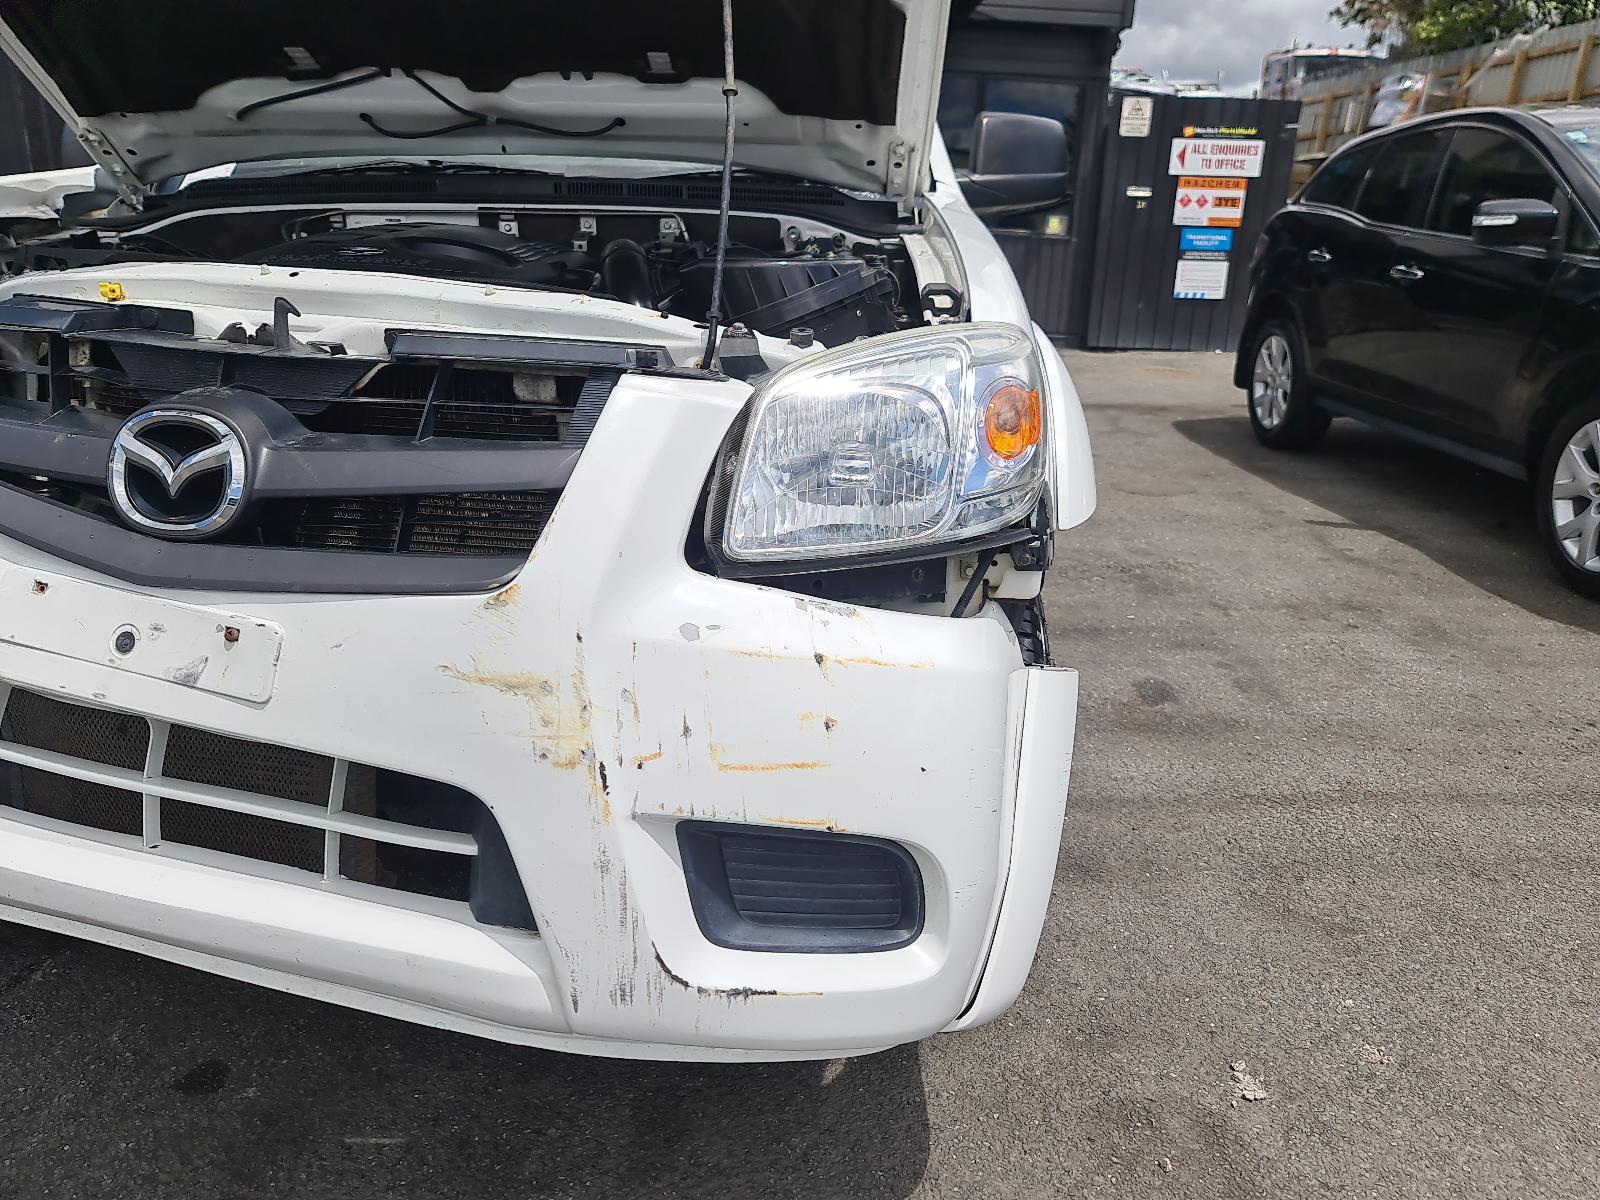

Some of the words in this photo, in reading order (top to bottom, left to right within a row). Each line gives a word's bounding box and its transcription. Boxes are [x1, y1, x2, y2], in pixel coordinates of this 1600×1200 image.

[1191, 143, 1207, 155] ALL
[1210, 144, 1259, 156] ENQUIRIES
[1201, 158, 1212, 170] TO
[1214, 159, 1246, 170] OFFICE
[1183, 179, 1240, 189] HAZCHEM
